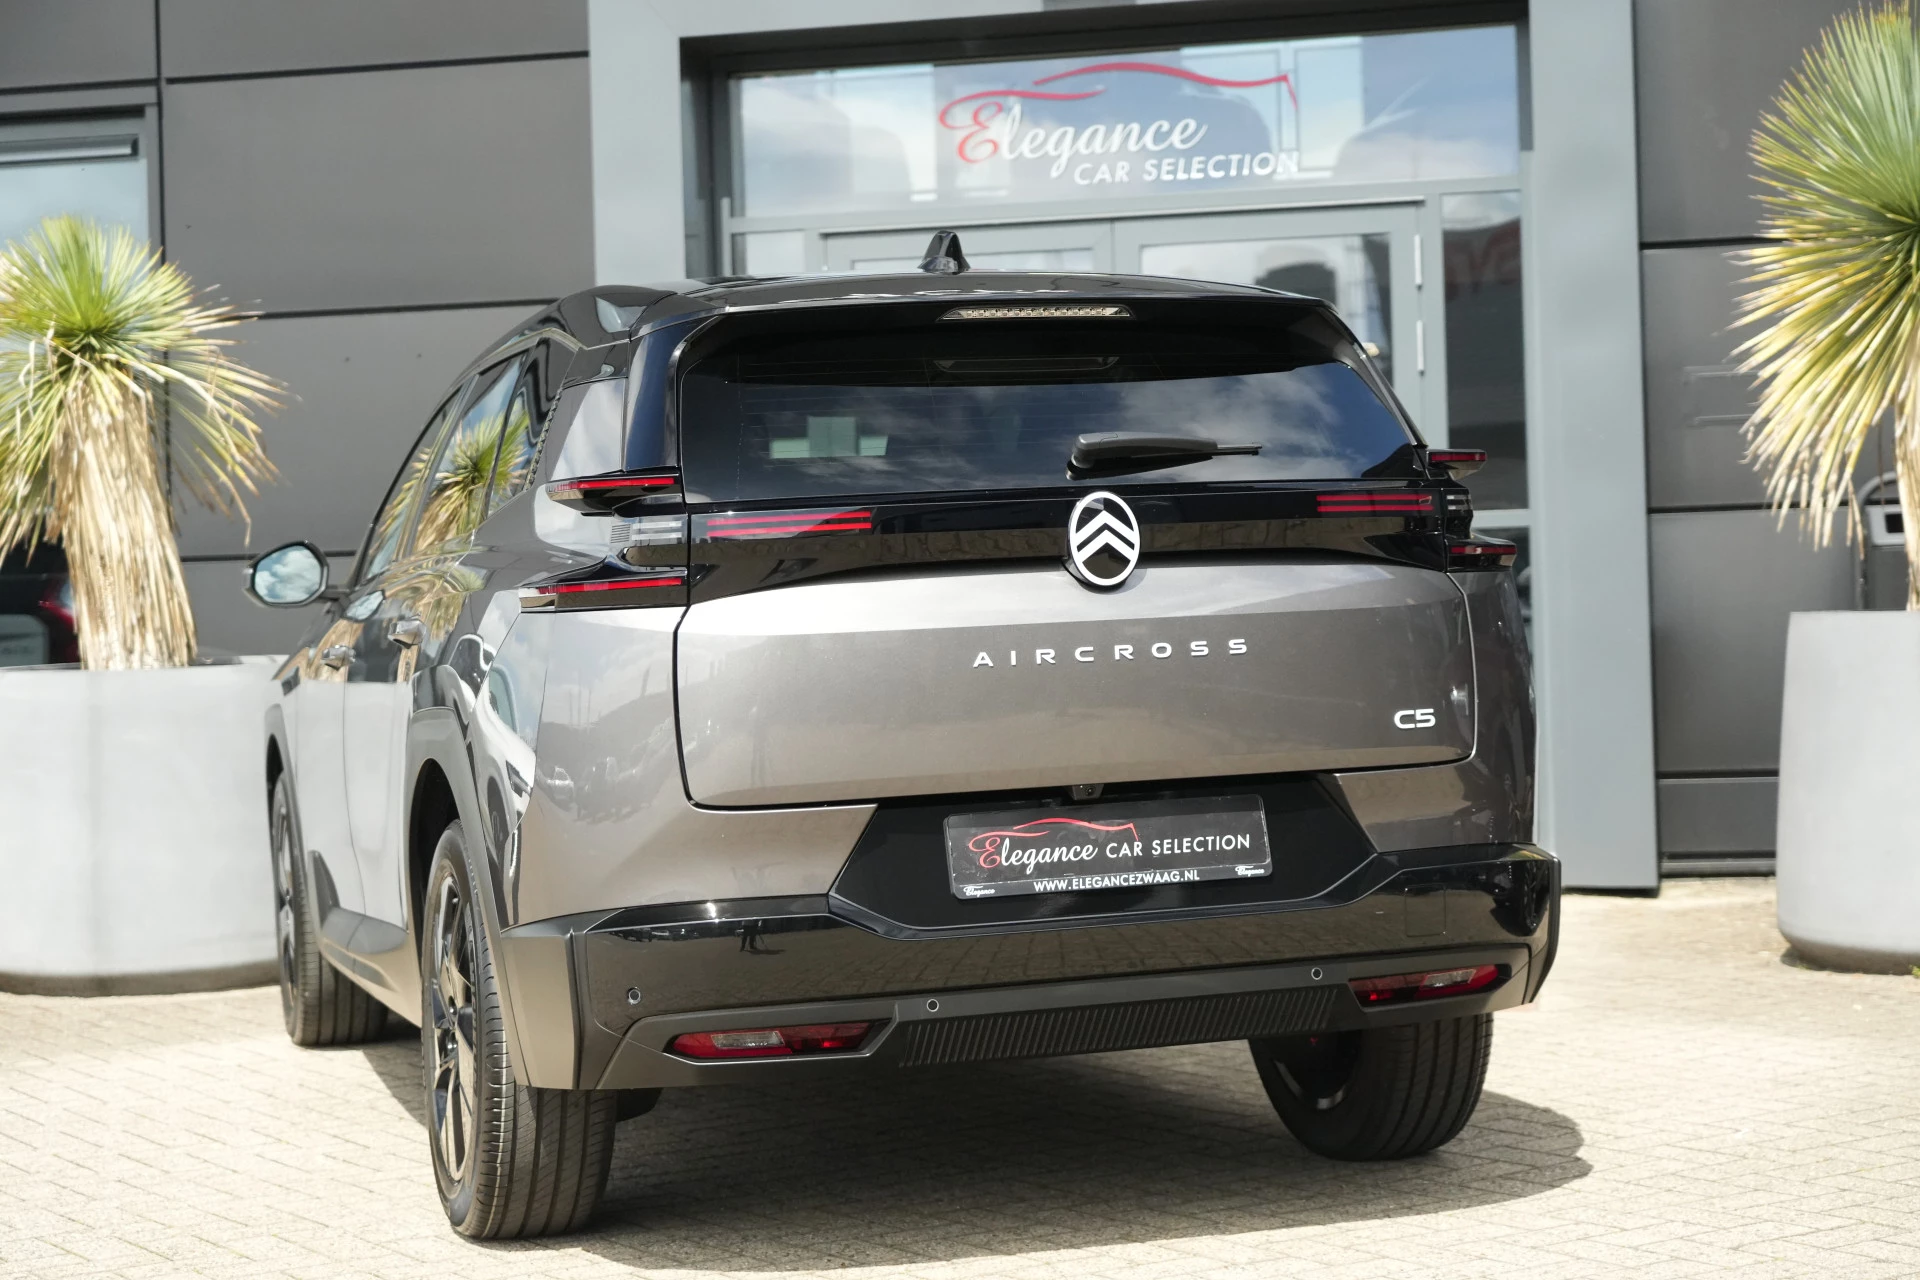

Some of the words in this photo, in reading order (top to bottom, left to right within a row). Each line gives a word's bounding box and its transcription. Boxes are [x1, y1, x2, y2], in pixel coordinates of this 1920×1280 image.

[939, 94, 1207, 179] Elegance
[1073, 159, 1130, 186] CAR
[1144, 151, 1300, 182] SELECTION
[972, 637, 1248, 668] AIRCROSS
[1393, 707, 1437, 730] C5
[968, 835, 1098, 875] Elegance
[1105, 841, 1143, 859] CAR
[1151, 833, 1251, 856] SELECTION
[1033, 868, 1201, 893] WWW.ELEGANCEZWAAG.NL
